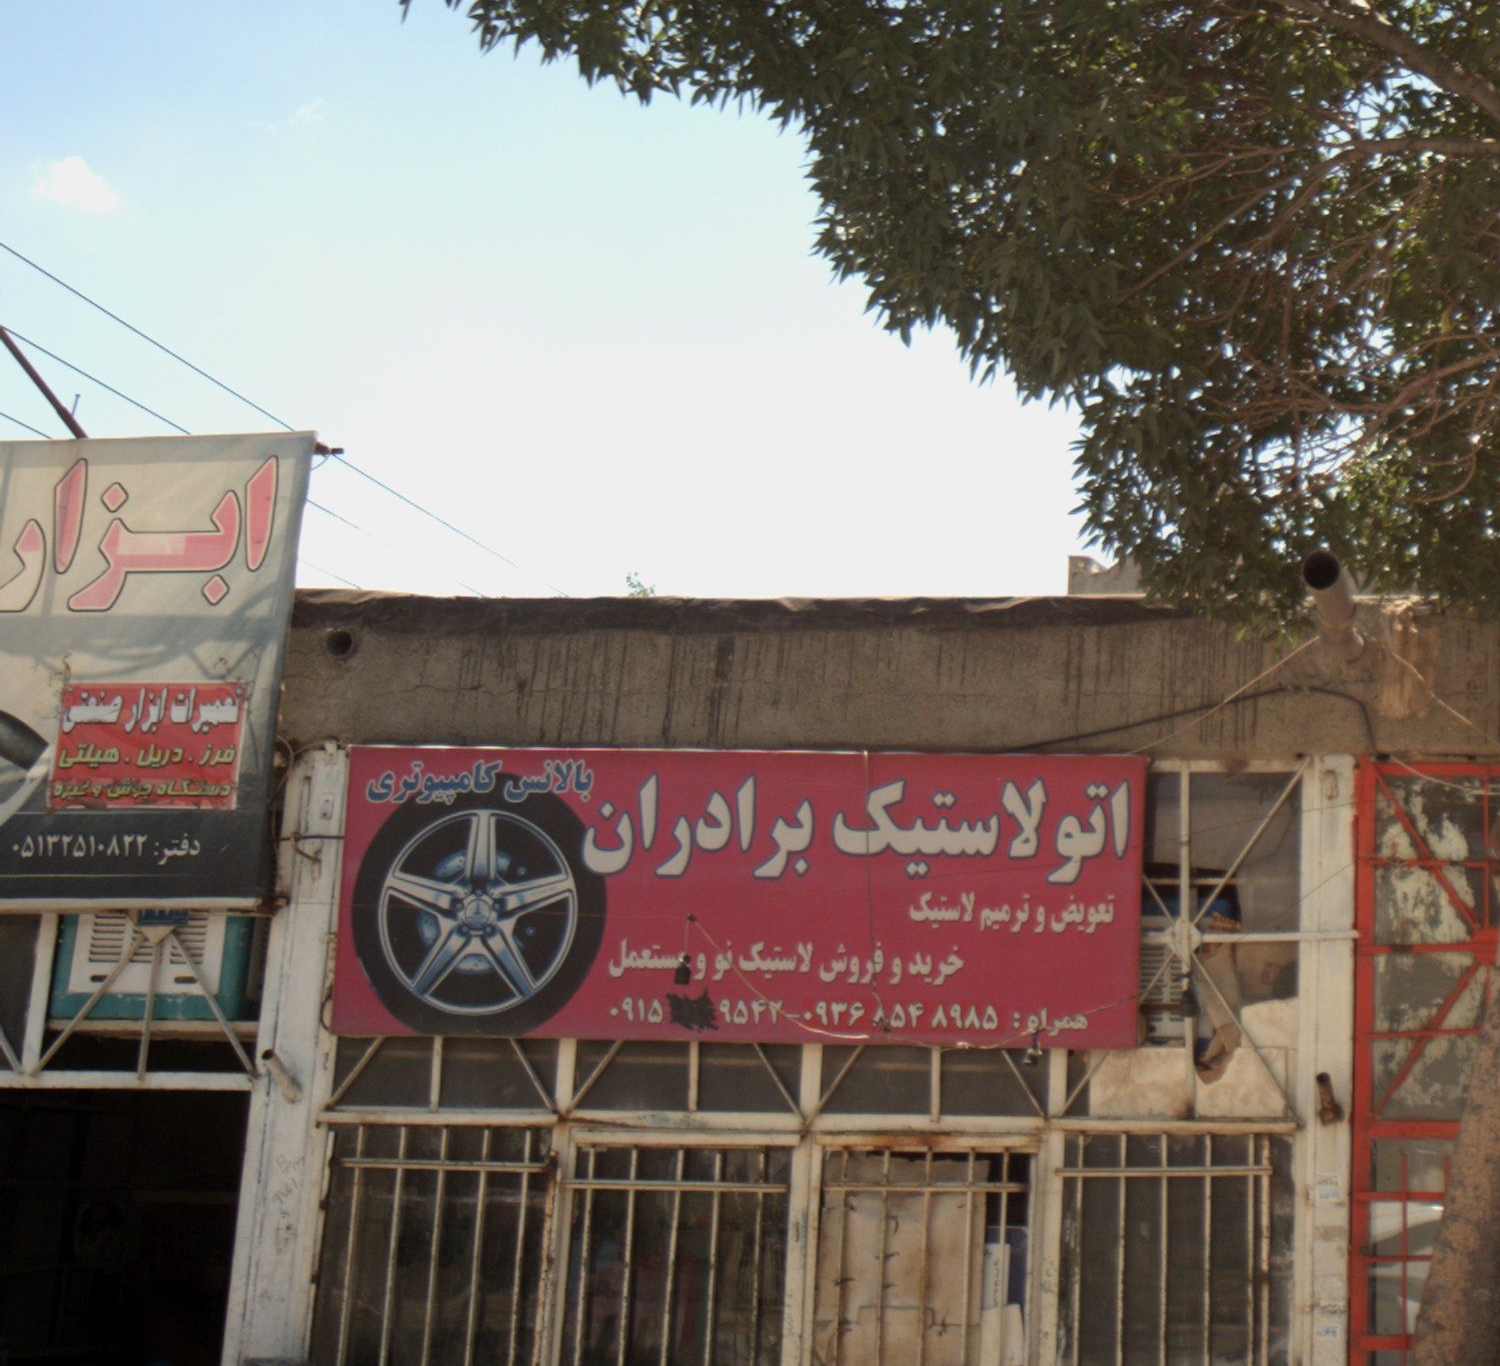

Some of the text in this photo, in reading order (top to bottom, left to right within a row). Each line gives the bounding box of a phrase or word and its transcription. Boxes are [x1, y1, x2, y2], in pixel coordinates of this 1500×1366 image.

[124, 686, 168, 733] ابزار
[366, 760, 595, 804] بالانس کامپیوتری
[581, 771, 815, 881] برادران
[908, 891, 1116, 934] تعویض و ترمیم لاستیک
[693, 952, 708, 981] و
[712, 940, 734, 981] نو
[738, 941, 815, 980] لاستیک
[818, 941, 885, 984] فروش
[888, 955, 903, 984] و
[908, 944, 964, 985] خرید
[609, 997, 665, 1024] ۰۹۱۵
[931, 1002, 999, 1030] ۸۹۸۵
